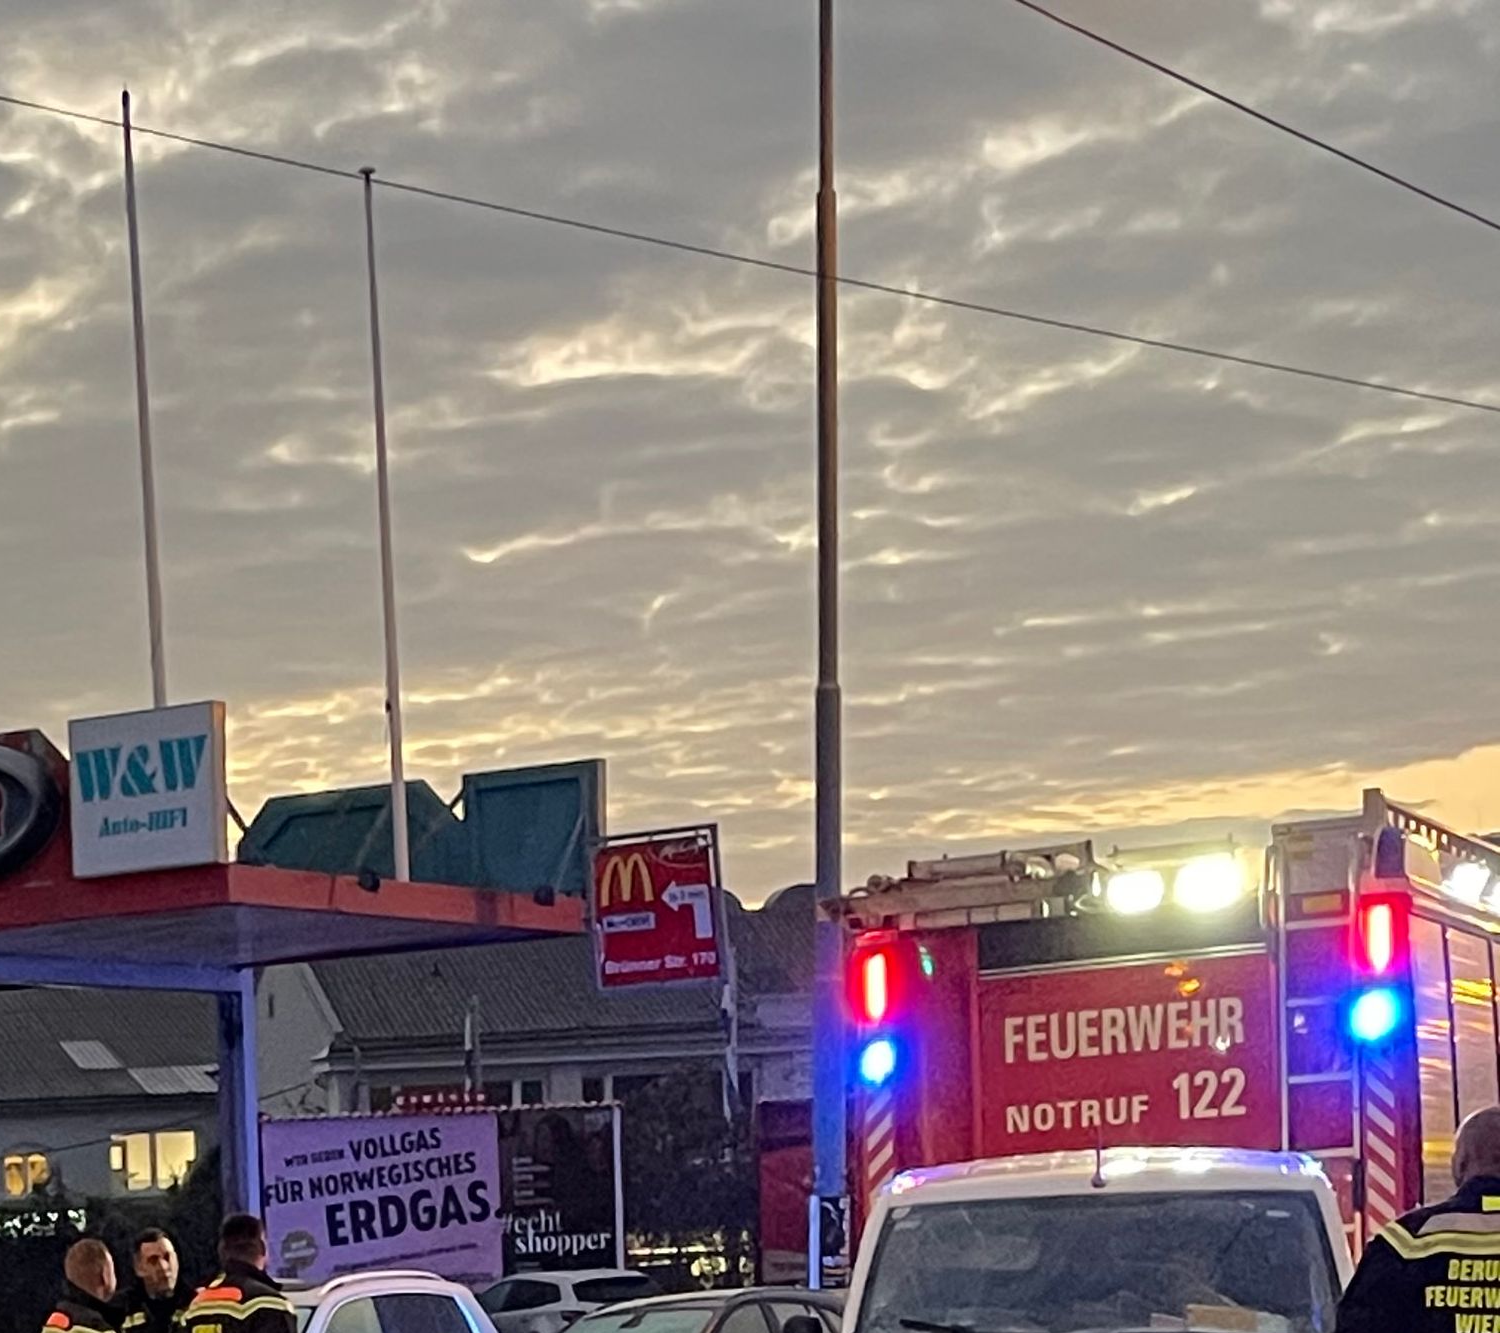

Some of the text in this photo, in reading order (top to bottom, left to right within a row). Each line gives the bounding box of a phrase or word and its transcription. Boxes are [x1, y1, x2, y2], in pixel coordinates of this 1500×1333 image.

[75, 734, 207, 802] W&W
[1004, 997, 1245, 1064] FEUERWEHR
[1006, 1067, 1247, 1134] NOTRUF 122
[349, 1127, 441, 1162] VOLLGAS
[265, 1175, 303, 1207] FÜR
[309, 1152, 476, 1199] NORWEGISCHES
[515, 1232, 611, 1257] shopper
